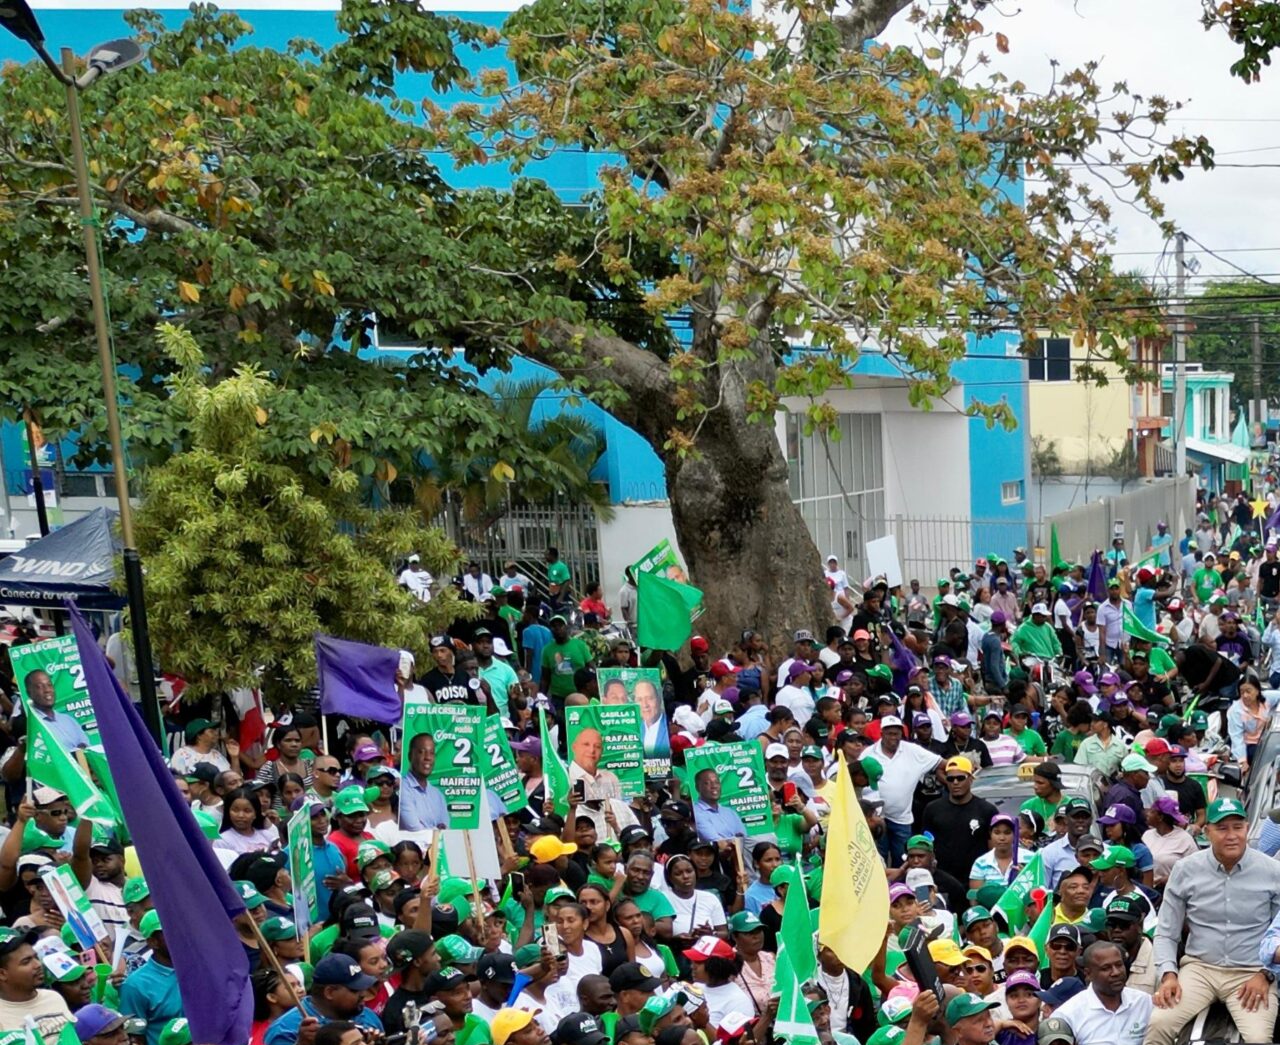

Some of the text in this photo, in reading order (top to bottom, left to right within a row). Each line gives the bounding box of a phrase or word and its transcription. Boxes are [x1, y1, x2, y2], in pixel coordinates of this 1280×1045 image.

[10, 555, 86, 576] WIND
[0, 588, 40, 599] Conecta
[43, 591, 55, 599] tu
[66, 699, 92, 712] MAIR
[453, 738, 472, 764] 2
[487, 744, 504, 766] 2
[440, 778, 480, 786] MAIRENI
[736, 766, 754, 788] 2
[445, 788, 476, 796] CASTRO
